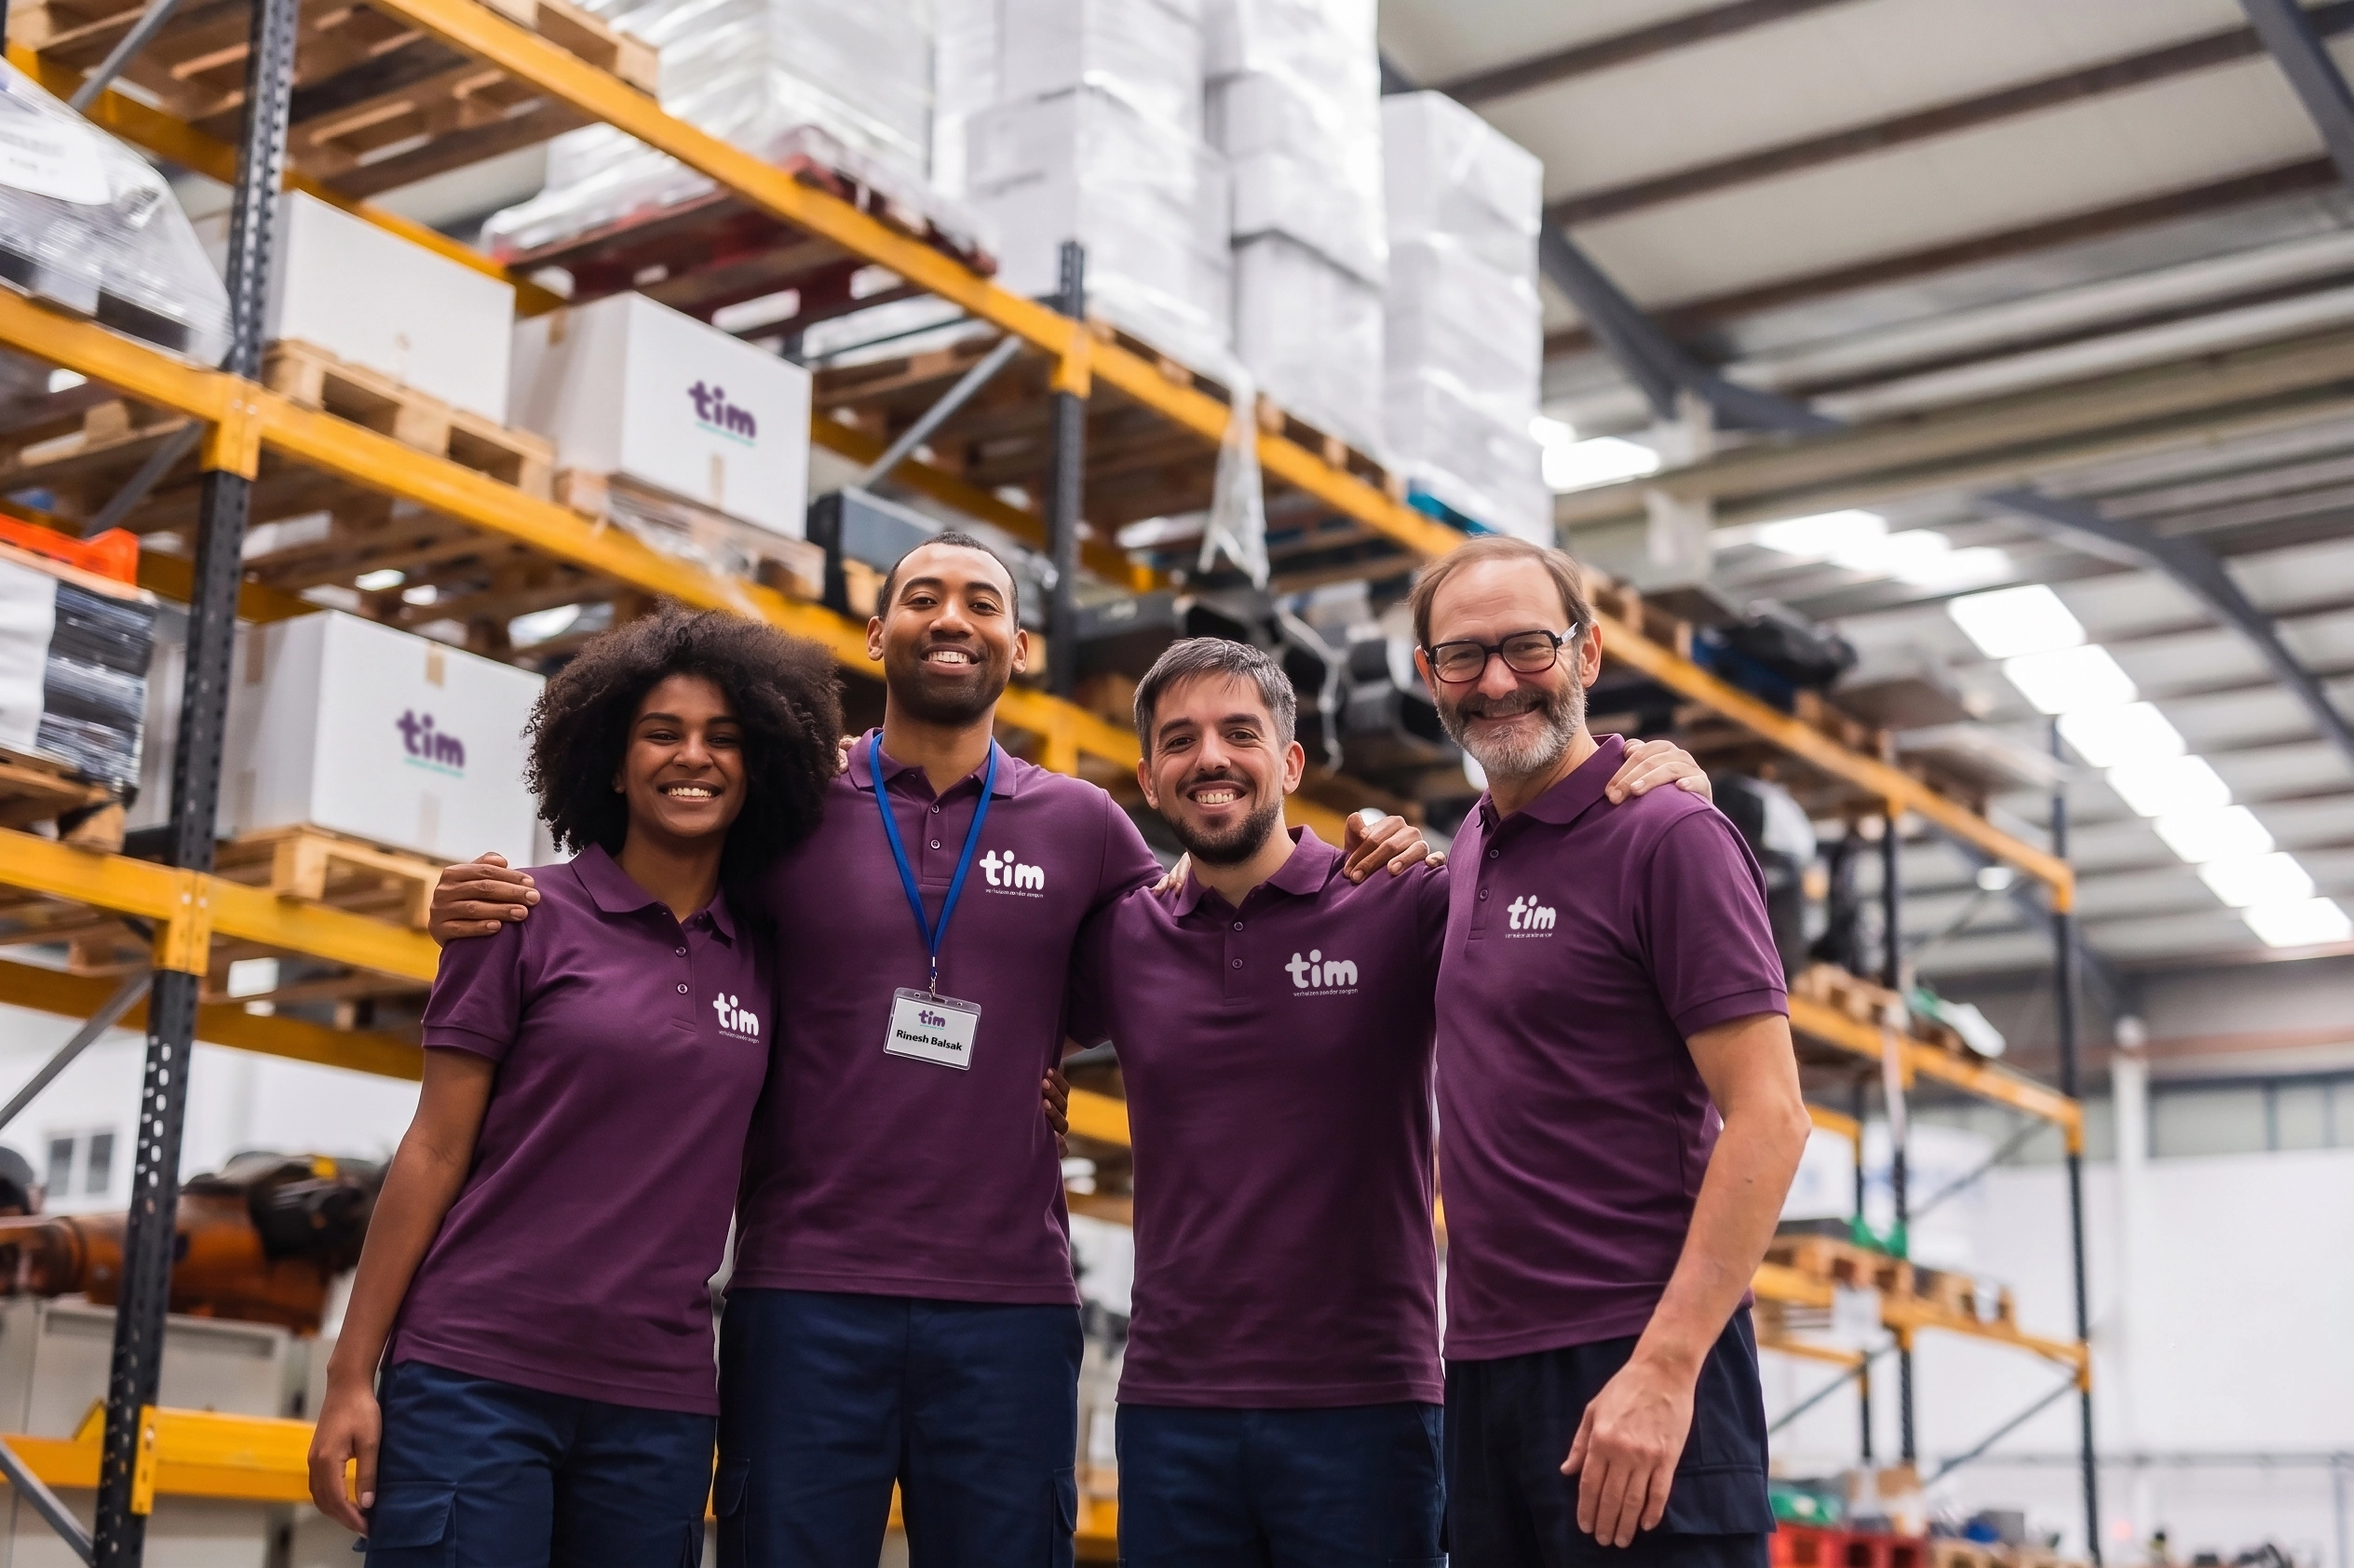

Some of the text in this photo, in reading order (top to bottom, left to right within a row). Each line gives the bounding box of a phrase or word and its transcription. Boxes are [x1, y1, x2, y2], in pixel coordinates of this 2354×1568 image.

[687, 380, 757, 439] tim
[396, 709, 466, 768] tim
[979, 850, 1045, 890] tim
[1507, 895, 1557, 930] tim
[1284, 949, 1359, 989] tim
[712, 992, 760, 1036] tim
[918, 1009, 946, 1027] tim
[896, 1029, 963, 1051] Rinesh Balsak
